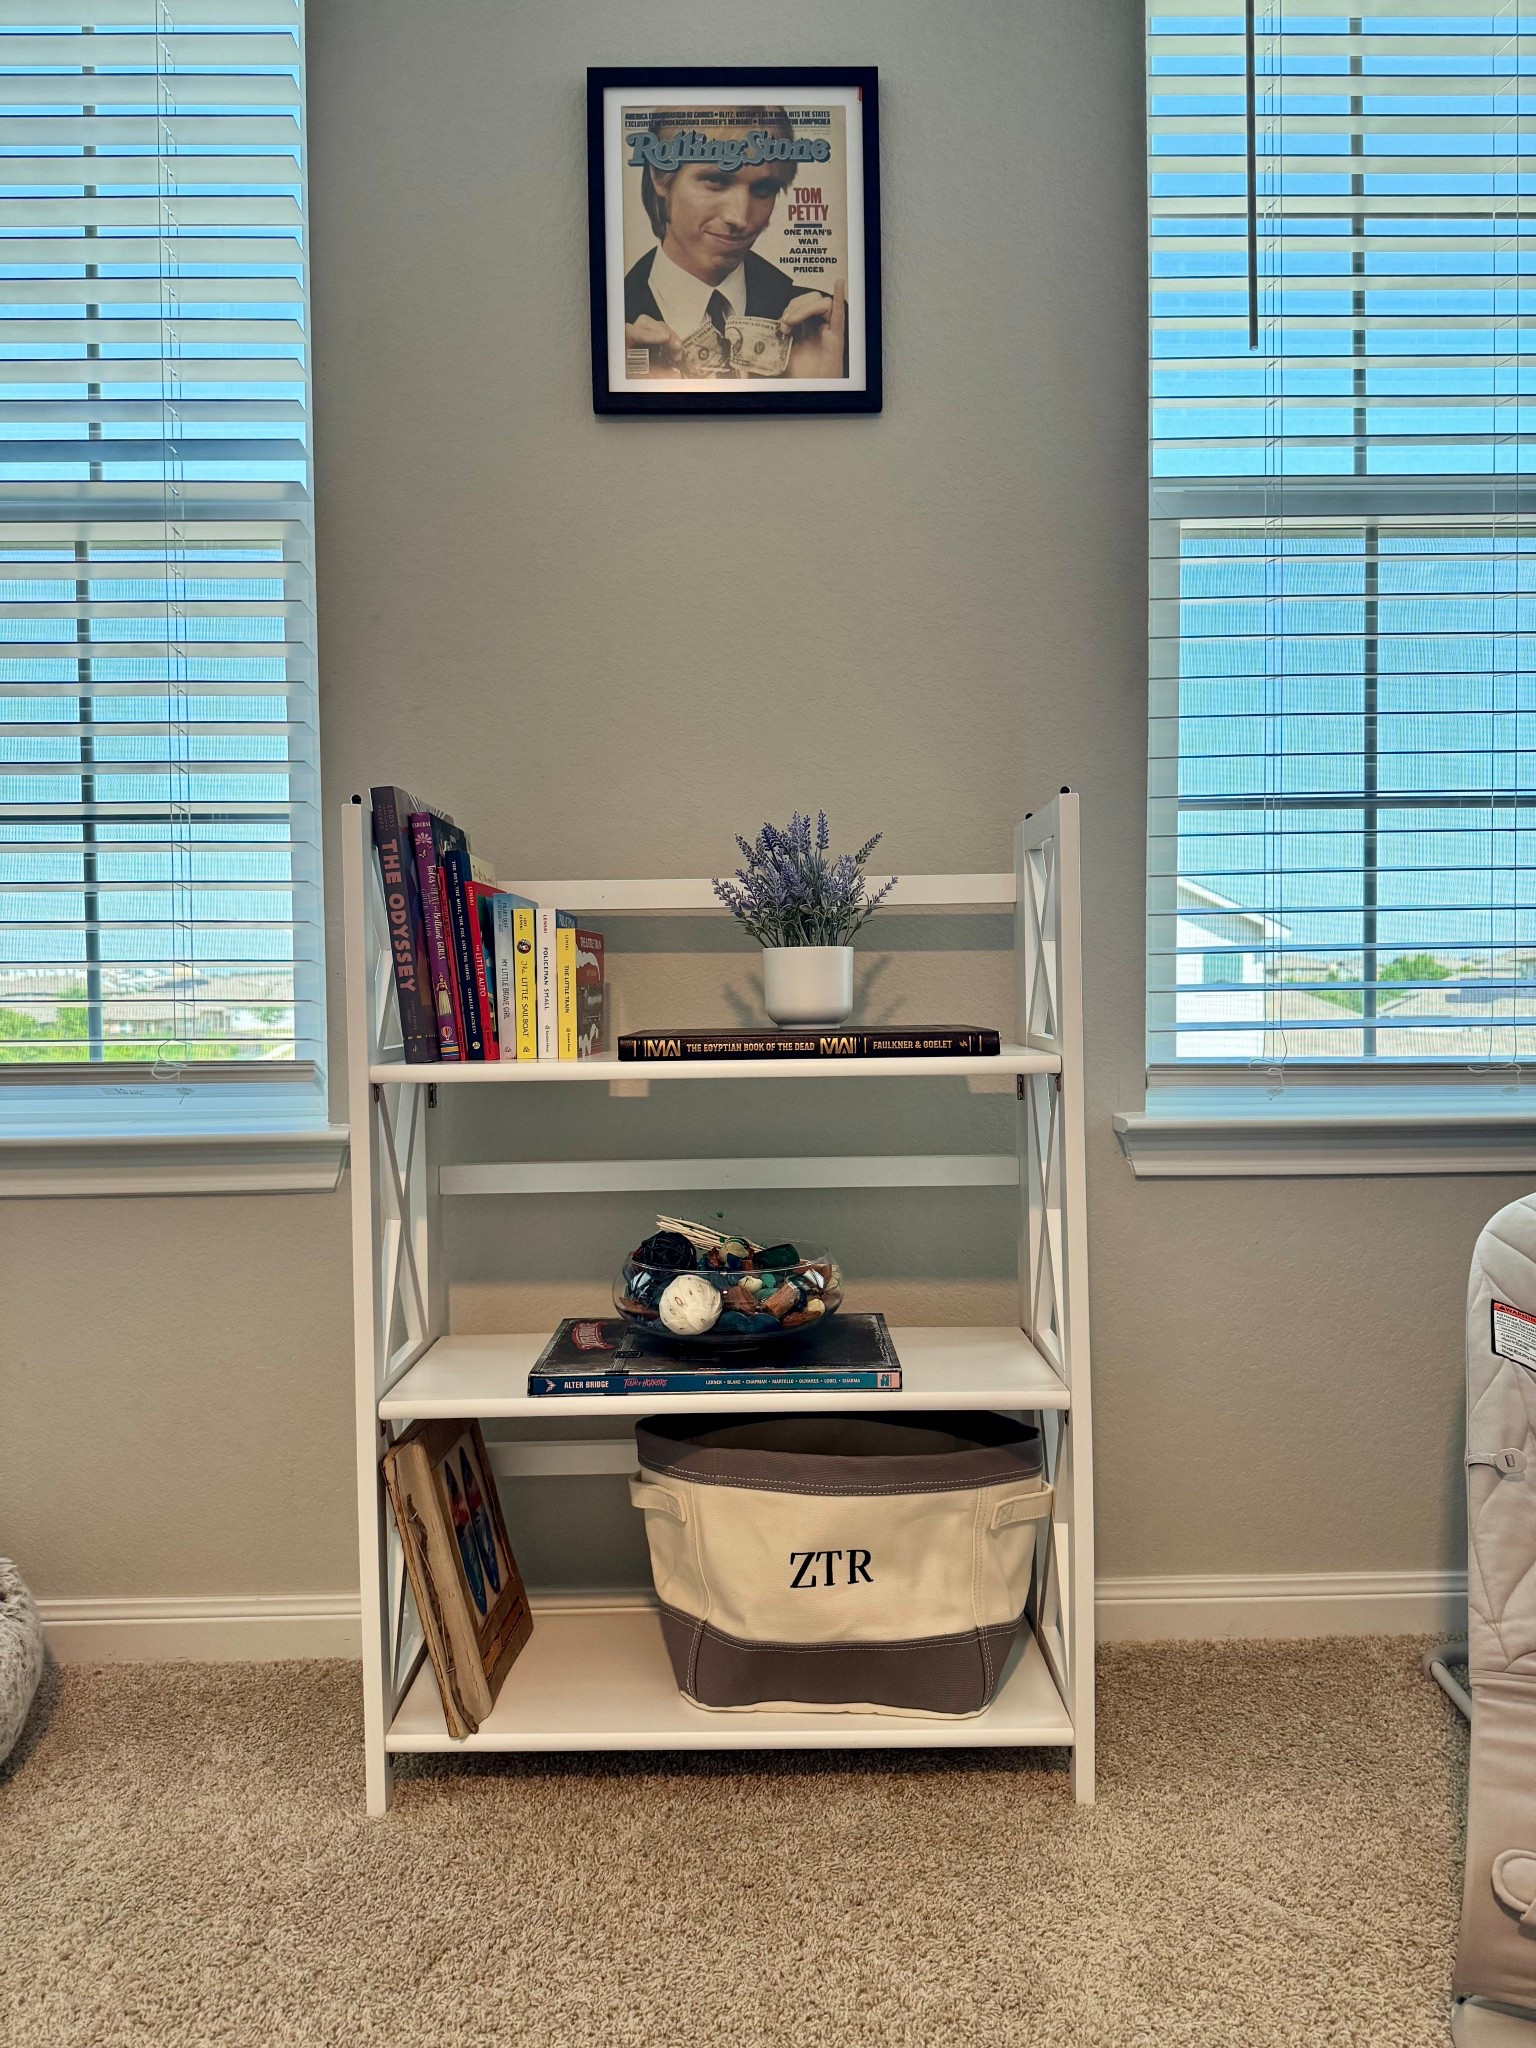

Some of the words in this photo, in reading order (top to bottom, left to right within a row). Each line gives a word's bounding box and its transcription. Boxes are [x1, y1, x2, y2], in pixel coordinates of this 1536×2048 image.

[626, 130, 746, 172] Rolling
[742, 130, 831, 168] Stone
[793, 187, 822, 204] TOM
[787, 204, 829, 221] PETTY
[779, 256, 801, 264] HIGH
[802, 256, 838, 264] RECORD
[387, 803, 396, 828] CROSS
[381, 838, 402, 884] THE
[467, 886, 475, 906] LENSKI
[388, 893, 417, 992] ODYSSEY
[437, 941, 447, 961] GIRLS
[475, 952, 484, 975] LITTLE
[501, 959, 508, 967] MY
[478, 976, 487, 997] AUTO
[521, 977, 529, 1001] LITTLE
[687, 1043, 701, 1052] THE
[703, 1043, 741, 1052] EGYPTIAN
[743, 1043, 764, 1051] BOOK
[765, 1042, 775, 1051] OF
[777, 1042, 793, 1051] THE
[794, 1042, 815, 1051] DEAD
[872, 1040, 914, 1050] FAULKNER
[914, 1040, 922, 1049] &
[923, 1039, 953, 1049] GOELET
[564, 1381, 584, 1389] ALTER
[585, 1380, 609, 1388] BRIDGE
[789, 1549, 874, 1588] ZTR
